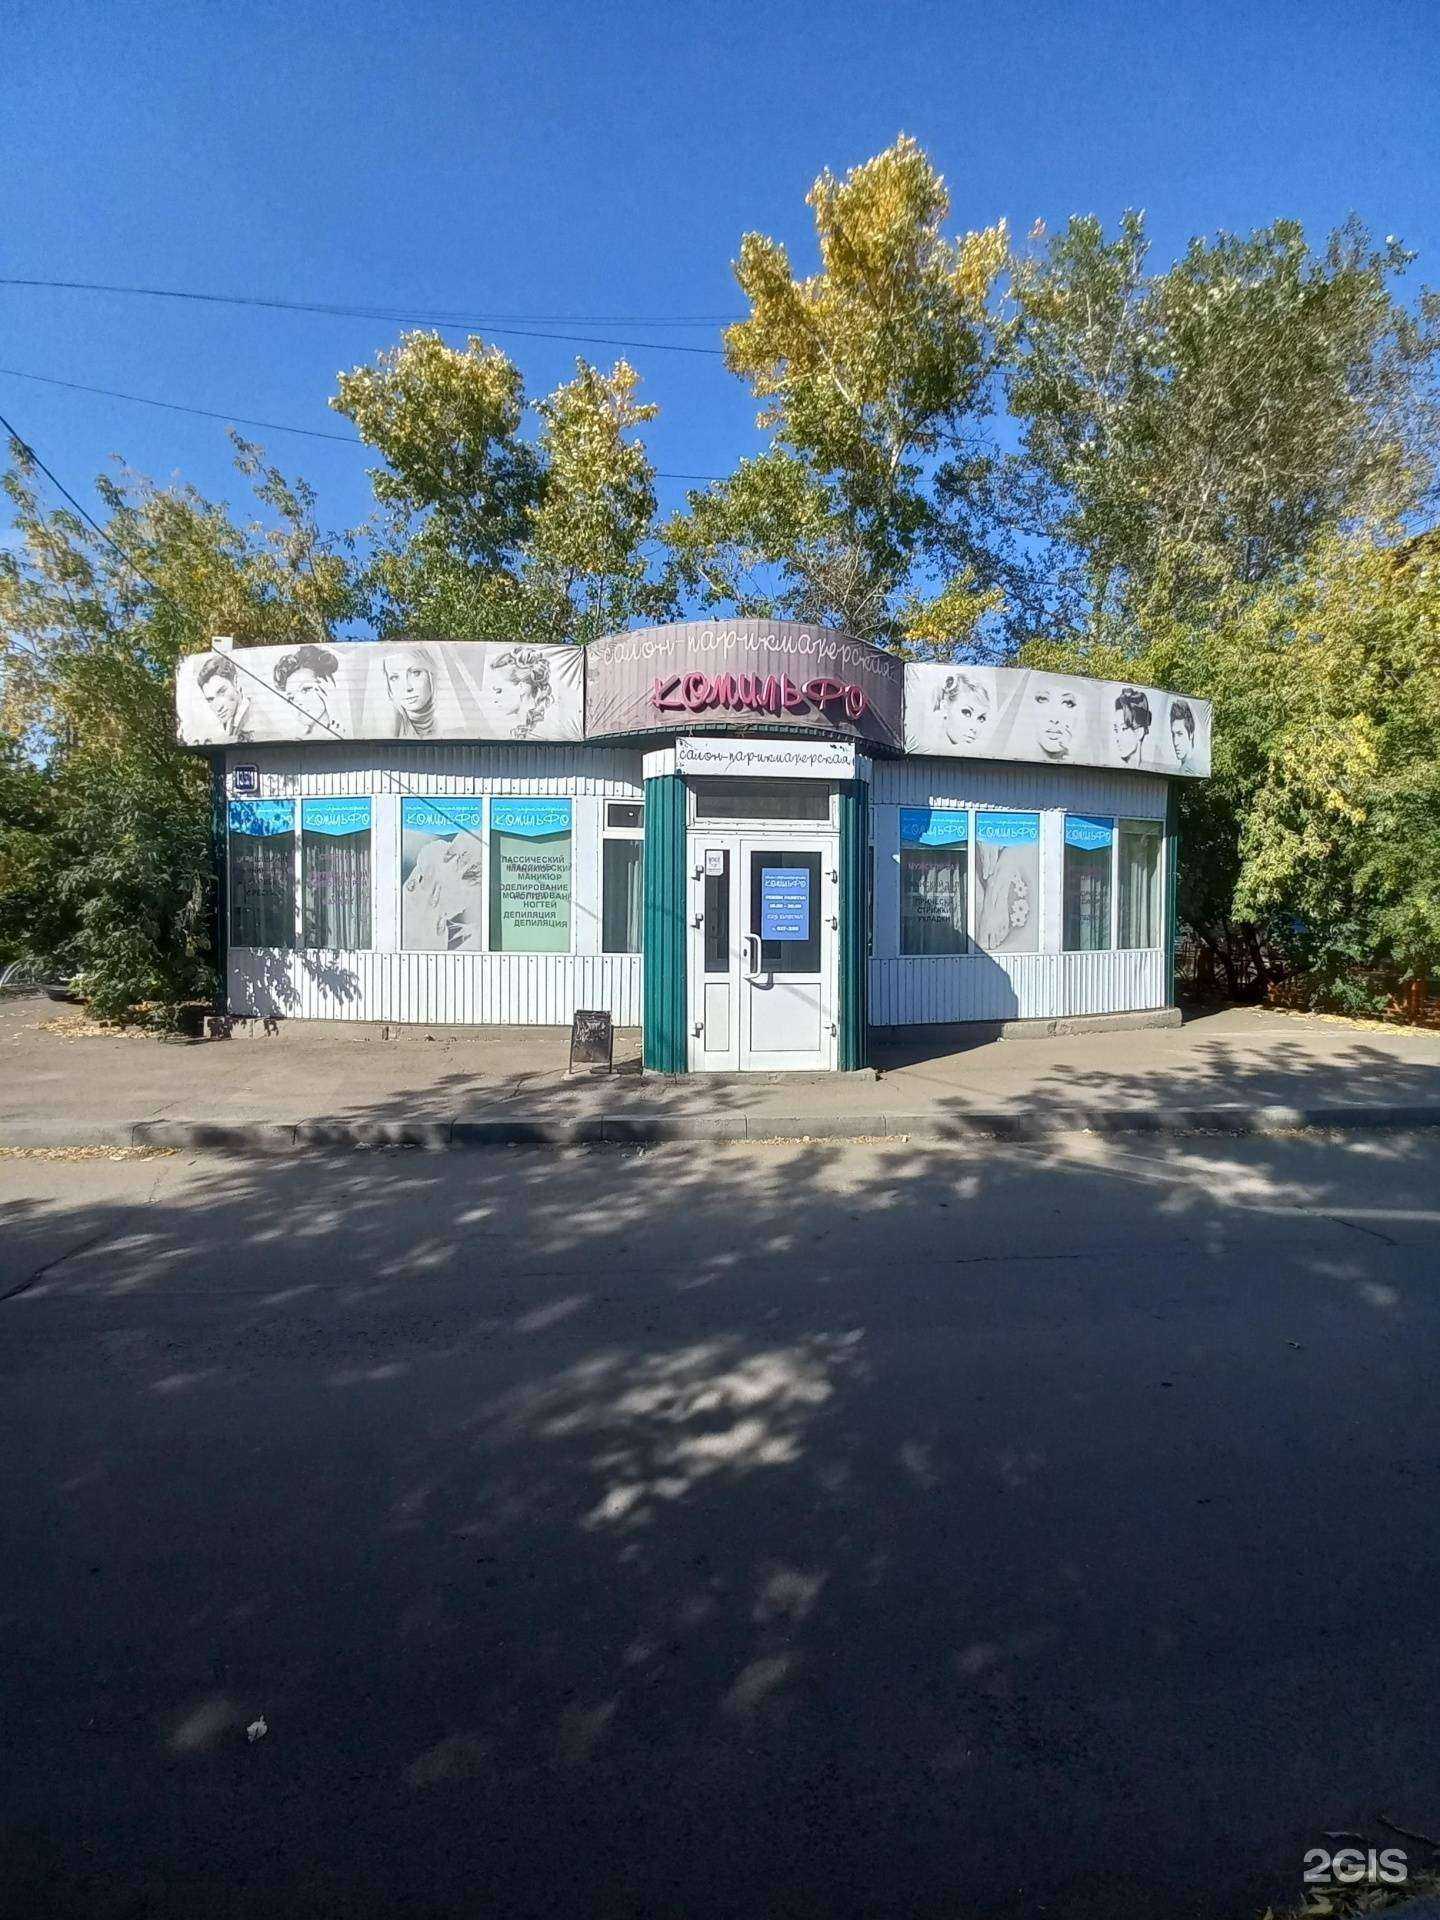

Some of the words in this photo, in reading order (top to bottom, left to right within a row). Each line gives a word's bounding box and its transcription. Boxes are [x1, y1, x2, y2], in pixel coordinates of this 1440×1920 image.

[650, 671, 870, 720] КОМИЛЬФО
[678, 748, 851, 767] салон-парикмахерская
[500, 855, 565, 864] ЛАССИЧЕСКИЙ
[499, 883, 569, 892] ОДЕЛИРОВАНИЕ
[523, 900, 558, 909] НОГТЕЙ
[503, 911, 557, 920] ДЕПИЛЯЦИЯ
[513, 919, 568, 928] ДЕПИЛЯЦИЯ
